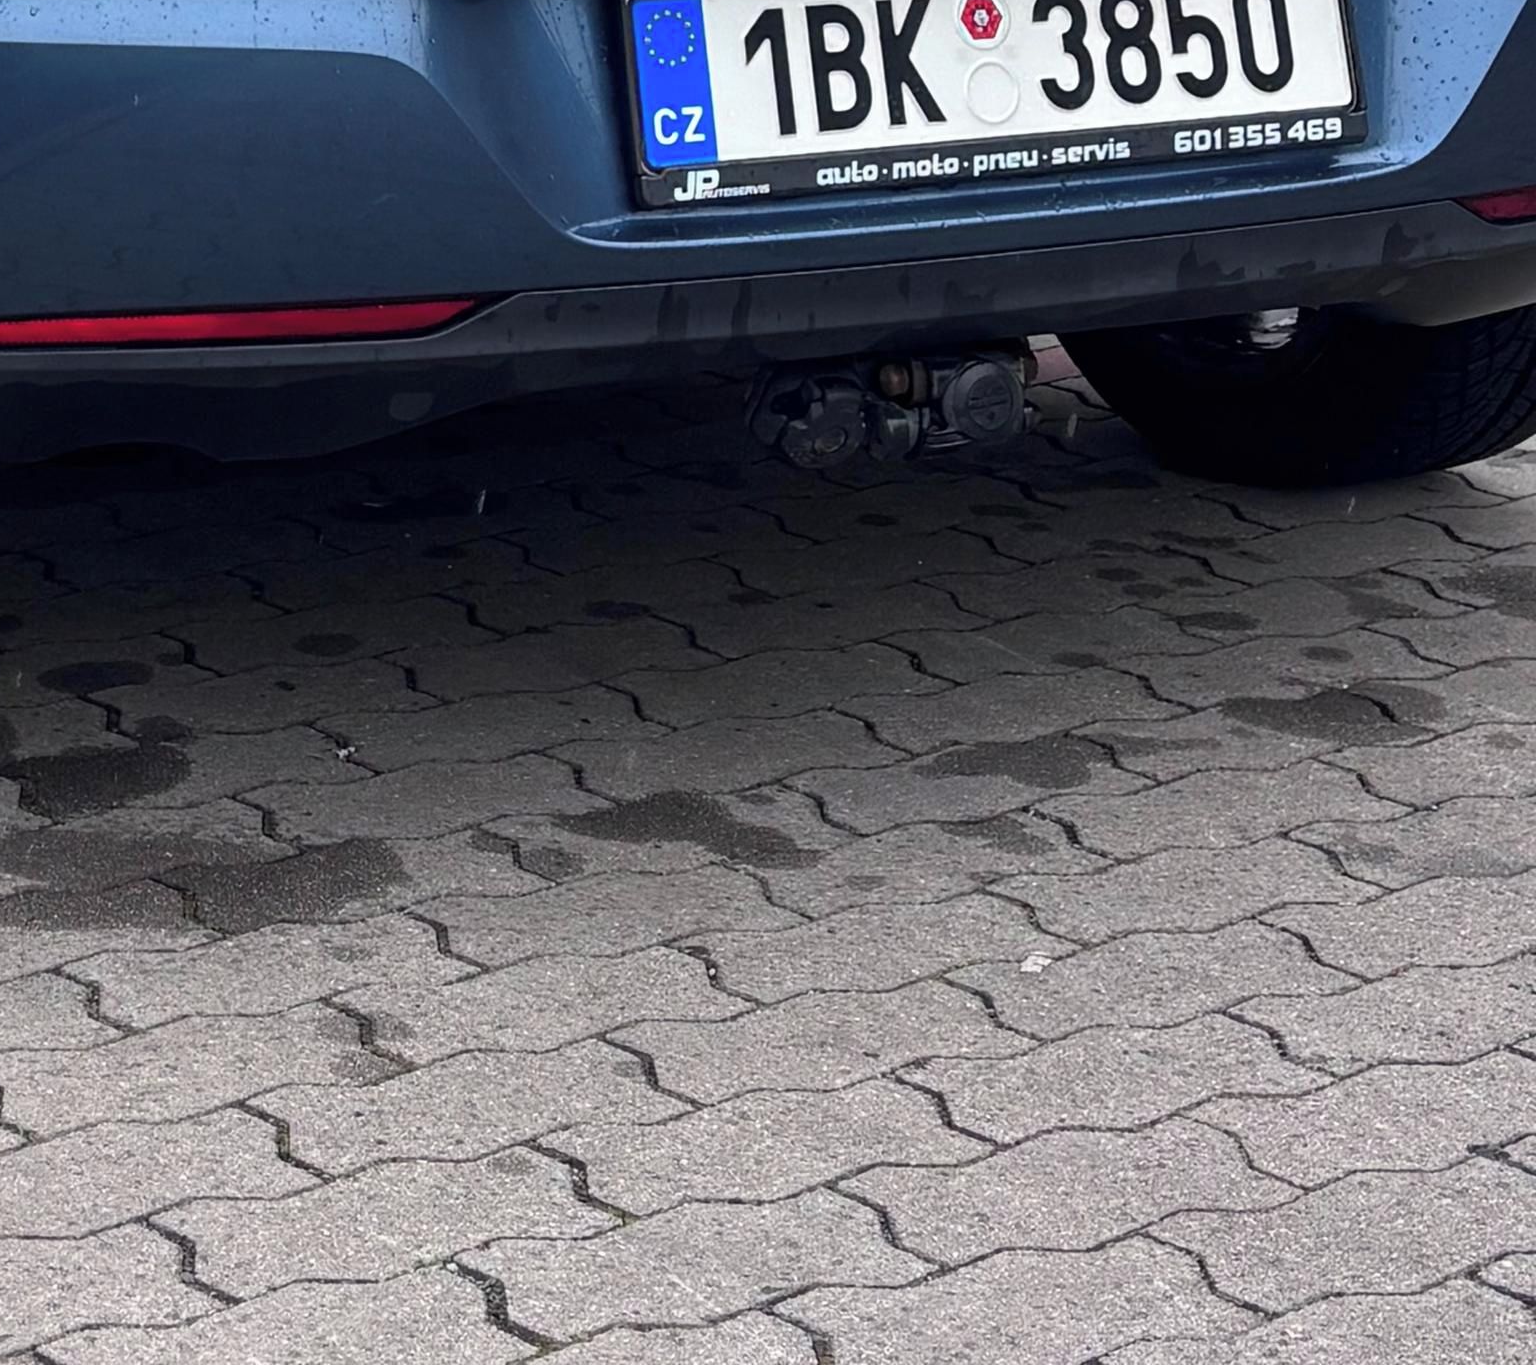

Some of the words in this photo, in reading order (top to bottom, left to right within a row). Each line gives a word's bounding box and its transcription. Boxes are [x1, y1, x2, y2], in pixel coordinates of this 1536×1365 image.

[653, 105, 707, 146] CZ
[1174, 127, 1222, 154] 601
[1228, 122, 1281, 149] 355
[1287, 116, 1342, 142] 469
[674, 169, 720, 202] JP
